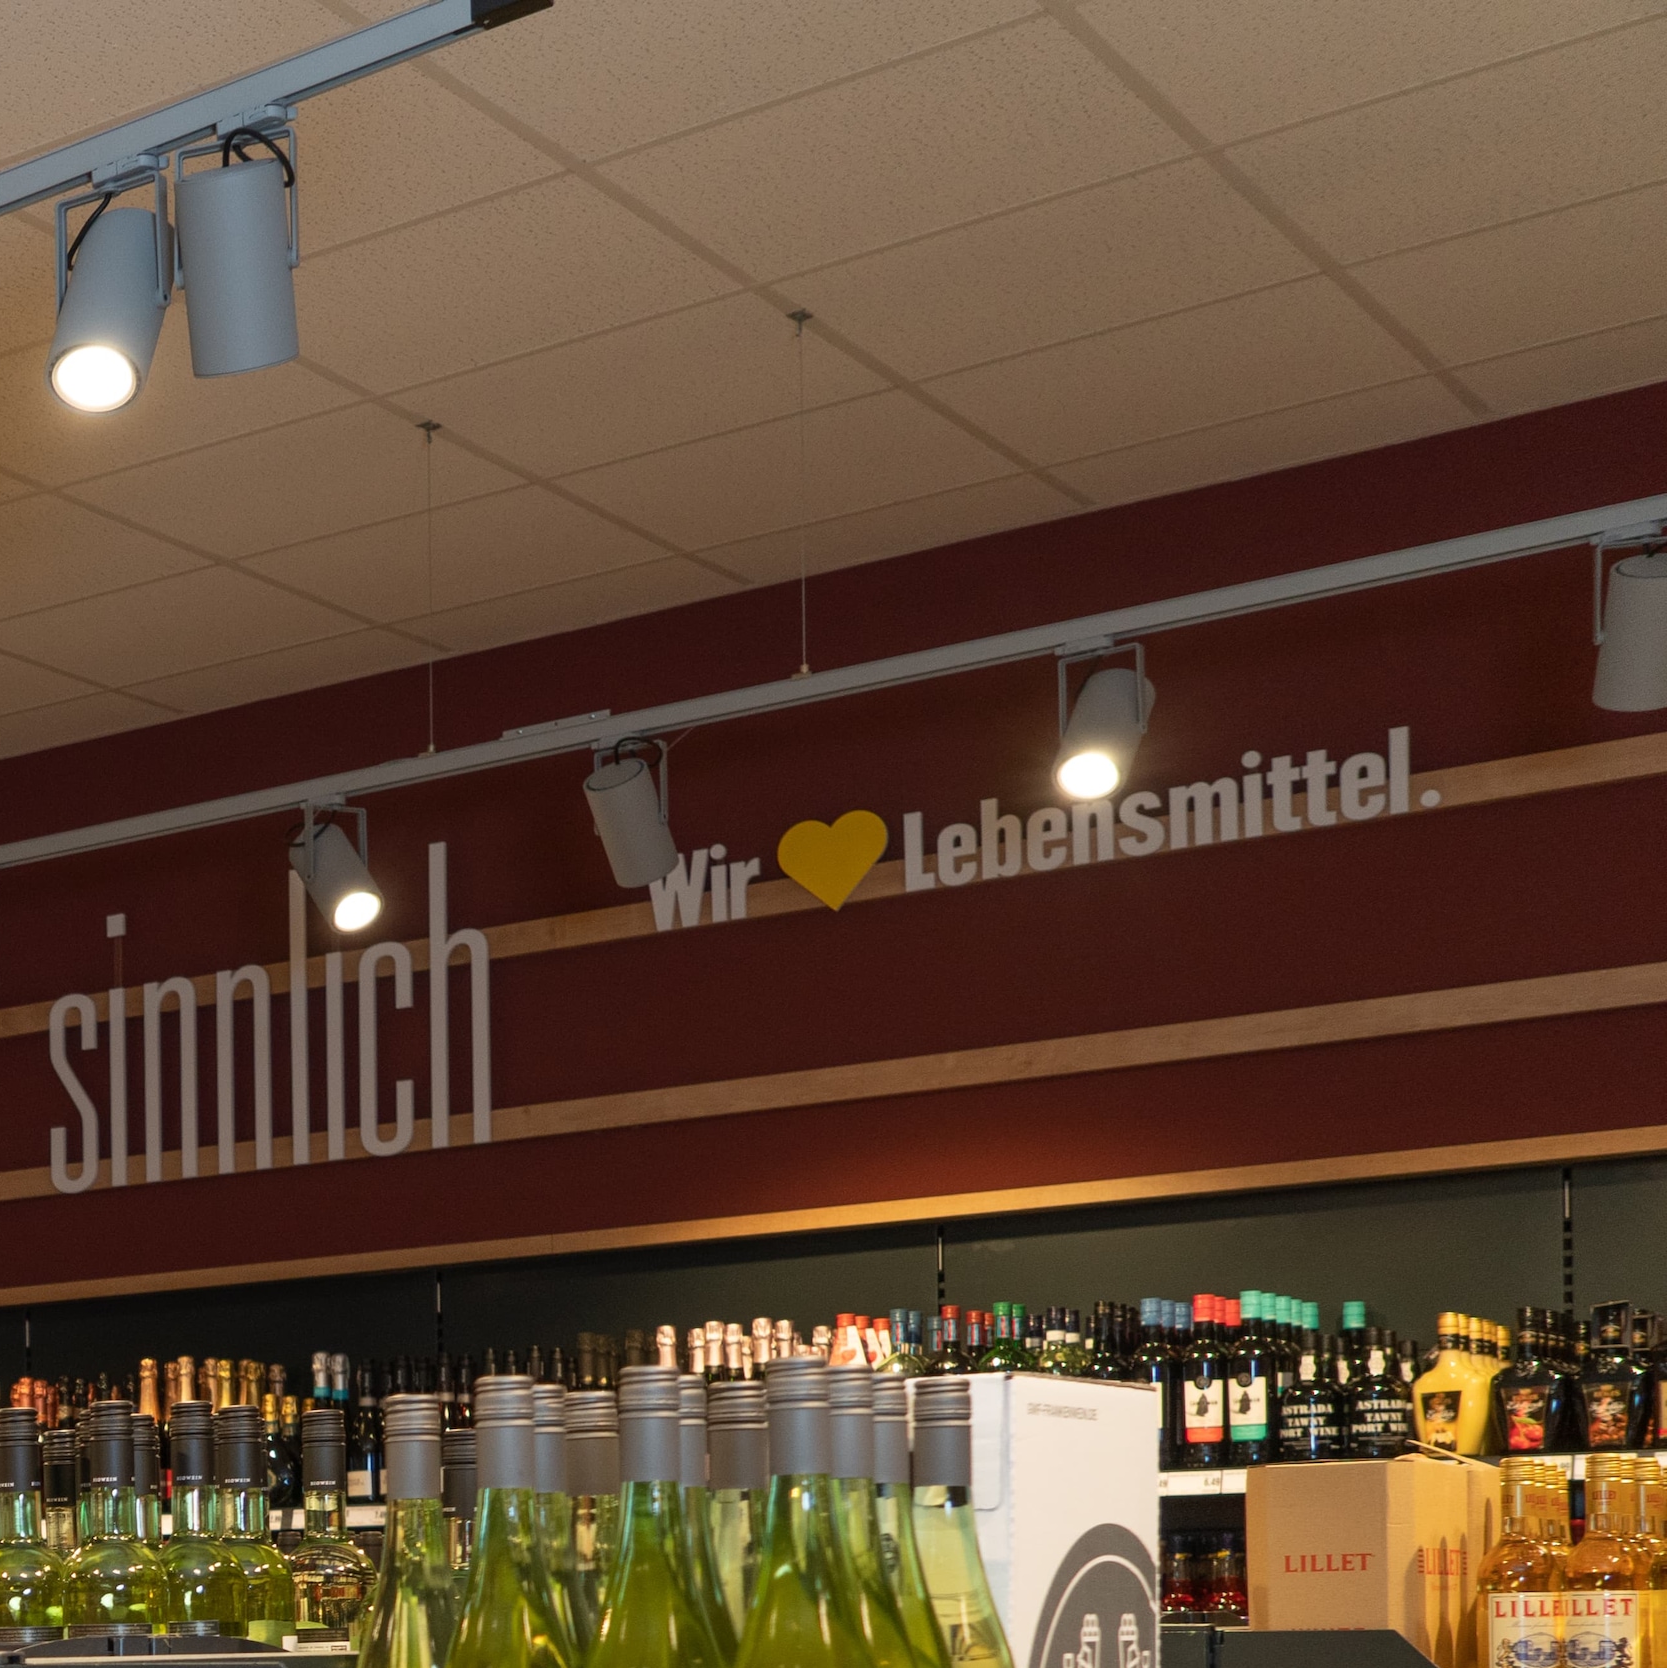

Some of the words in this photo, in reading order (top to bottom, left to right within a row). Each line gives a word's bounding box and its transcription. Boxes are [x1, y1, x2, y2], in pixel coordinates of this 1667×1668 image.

[649, 844, 761, 932] Wir
[903, 726, 1443, 892] Lebensmittel.
[48, 841, 492, 1194] sinnlich
[1284, 1552, 1373, 1574] LILLET
